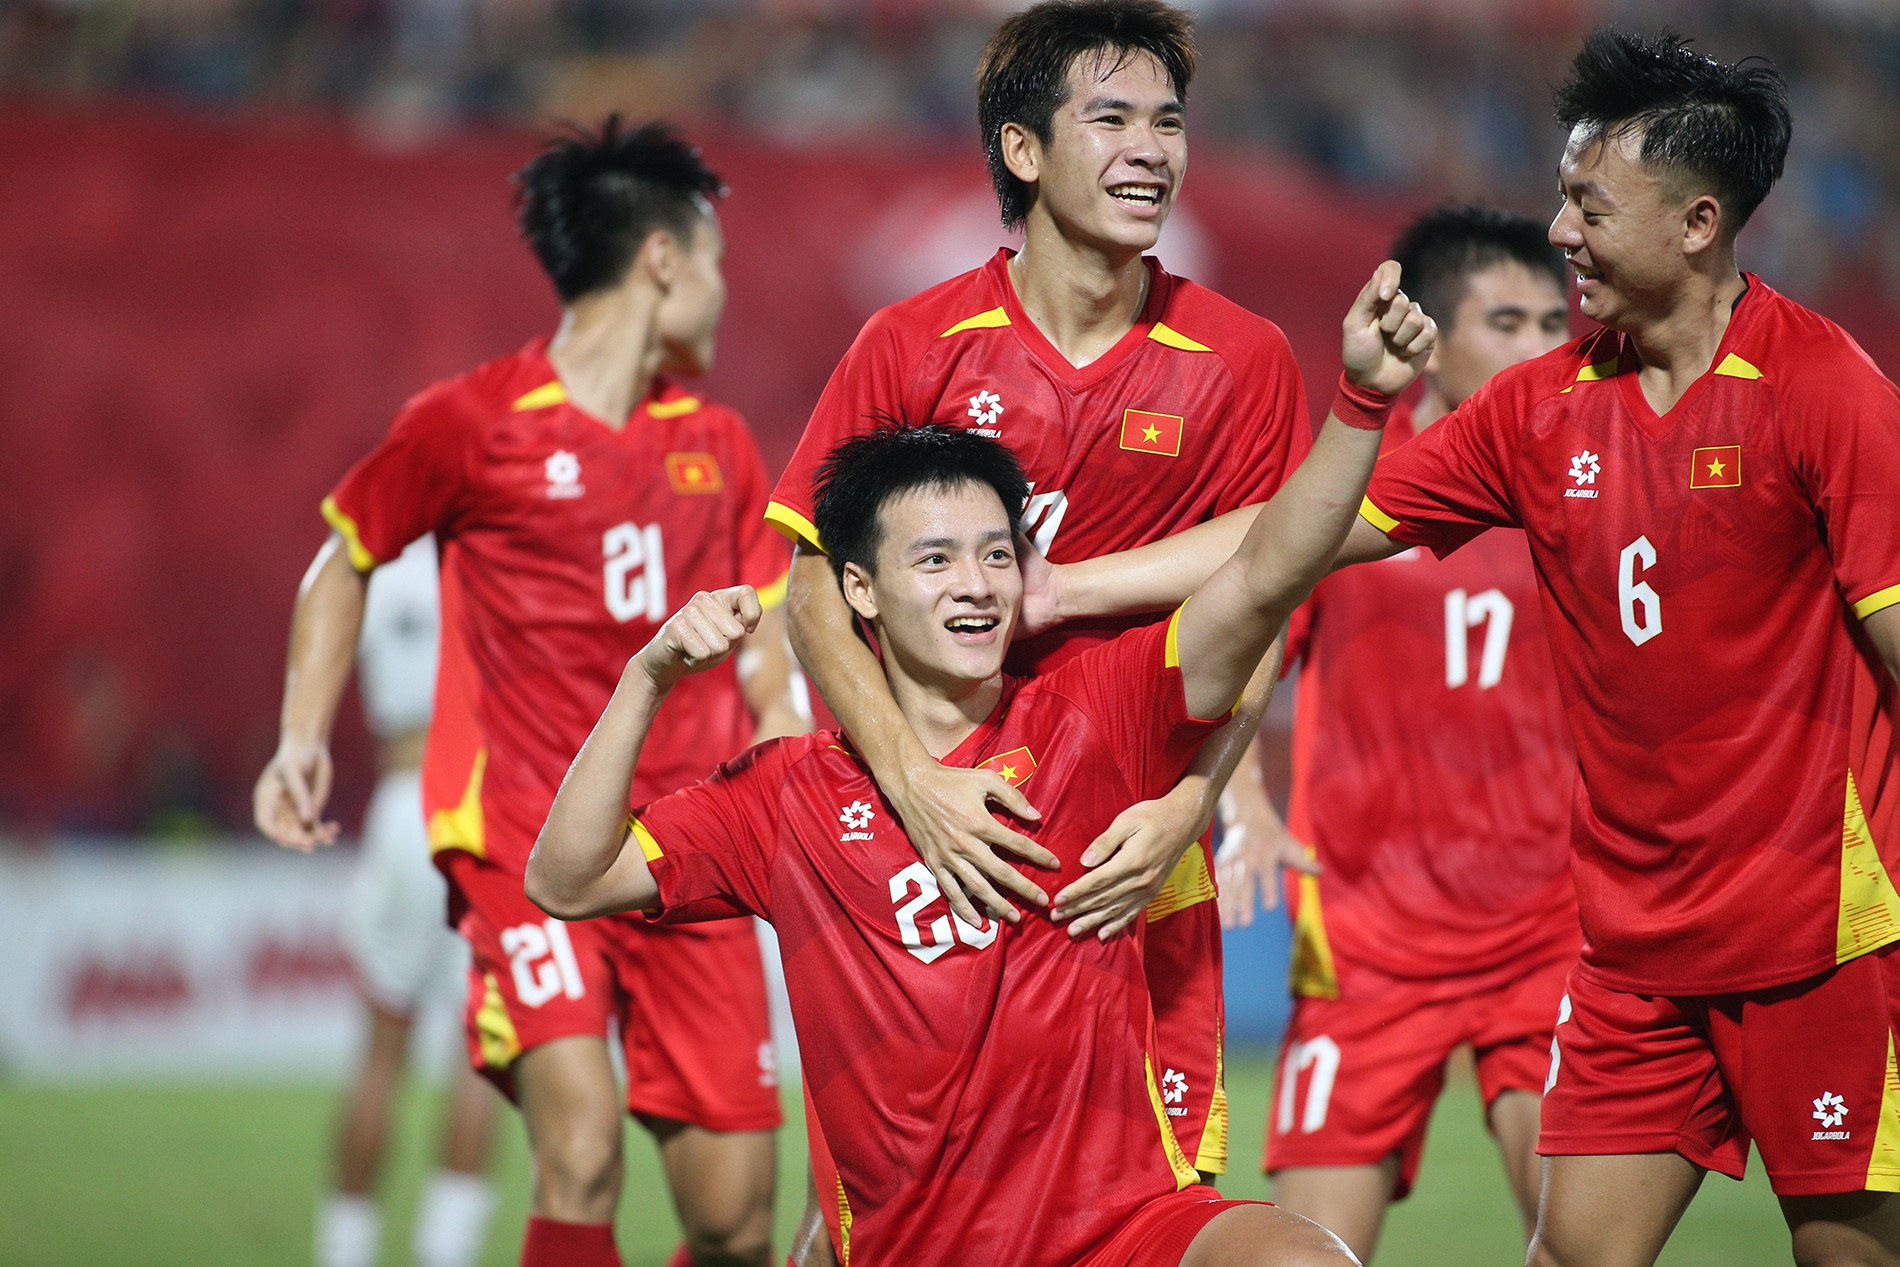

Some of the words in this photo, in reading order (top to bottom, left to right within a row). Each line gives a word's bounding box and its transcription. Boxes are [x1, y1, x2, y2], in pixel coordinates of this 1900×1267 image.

[602, 521, 668, 623] 21
[1618, 534, 1663, 647] 6
[1444, 587, 1514, 690] 17
[500, 917, 586, 1009] 21
[1277, 1034, 1341, 1134] 17
